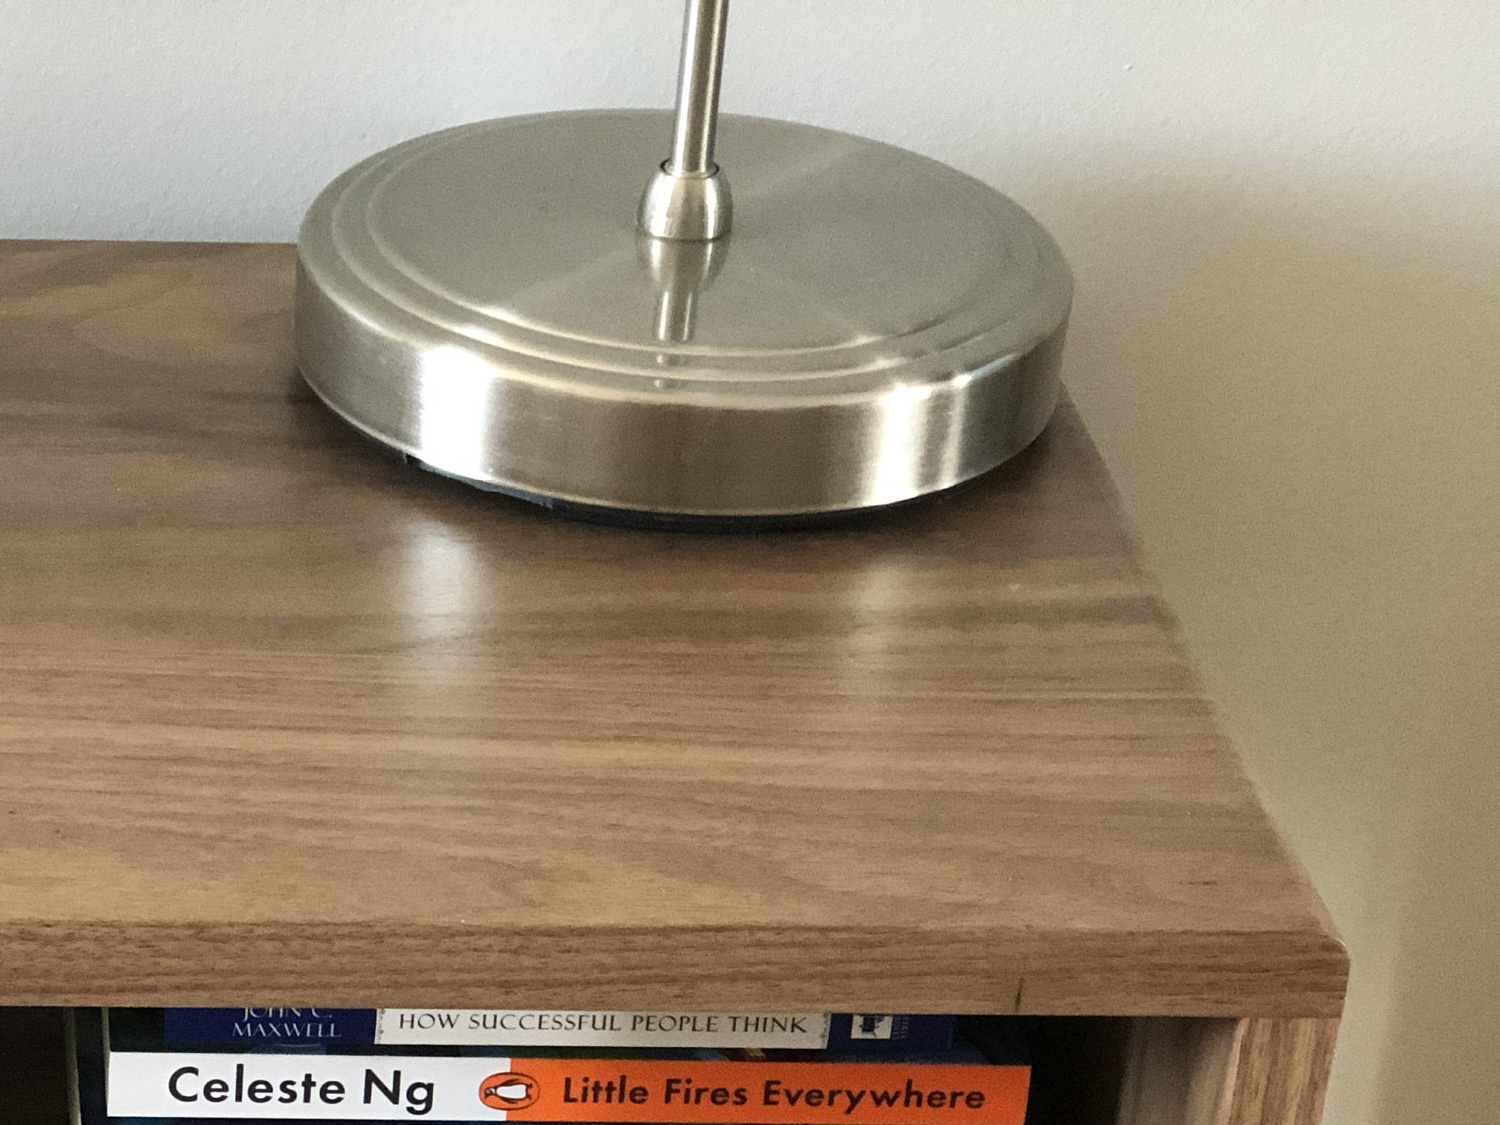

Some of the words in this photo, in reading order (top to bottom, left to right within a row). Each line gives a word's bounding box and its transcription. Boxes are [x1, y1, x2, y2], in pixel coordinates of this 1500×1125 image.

[232, 1022, 342, 1037] MAXWELL
[399, 1013, 460, 1030] HOW
[468, 1013, 622, 1031] SUCCESSFUL
[631, 1014, 719, 1033] PEOPLE
[728, 1016, 808, 1033] THINK
[168, 1063, 346, 1104] Celeste
[363, 1069, 435, 1115] Ng
[563, 1075, 650, 1105] Little
[664, 1079, 749, 1106] Fires
[762, 1079, 986, 1115] Everywhere
